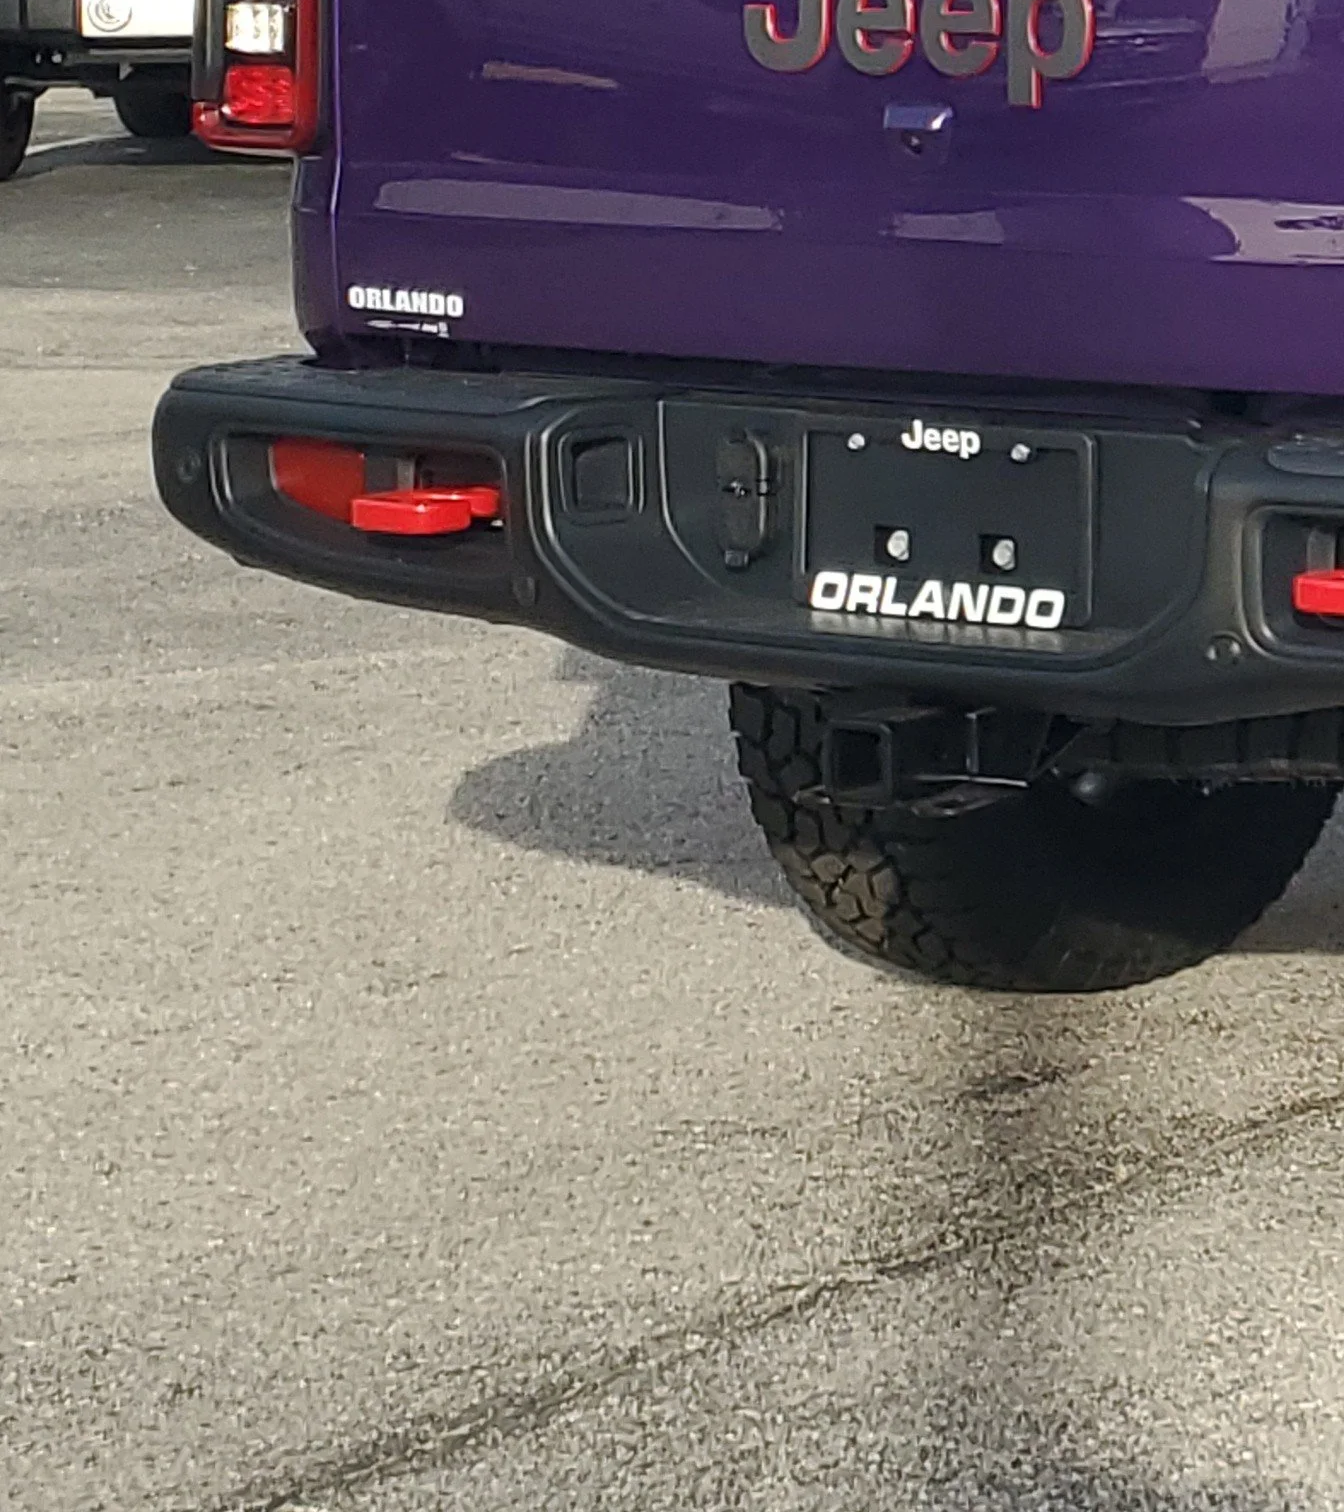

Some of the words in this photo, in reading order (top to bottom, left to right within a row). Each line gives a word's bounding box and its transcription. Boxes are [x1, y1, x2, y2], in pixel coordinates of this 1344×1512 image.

[348, 285, 464, 318] ORLANDO
[901, 419, 980, 459] Jeep
[809, 571, 1065, 629] ORLANDO
